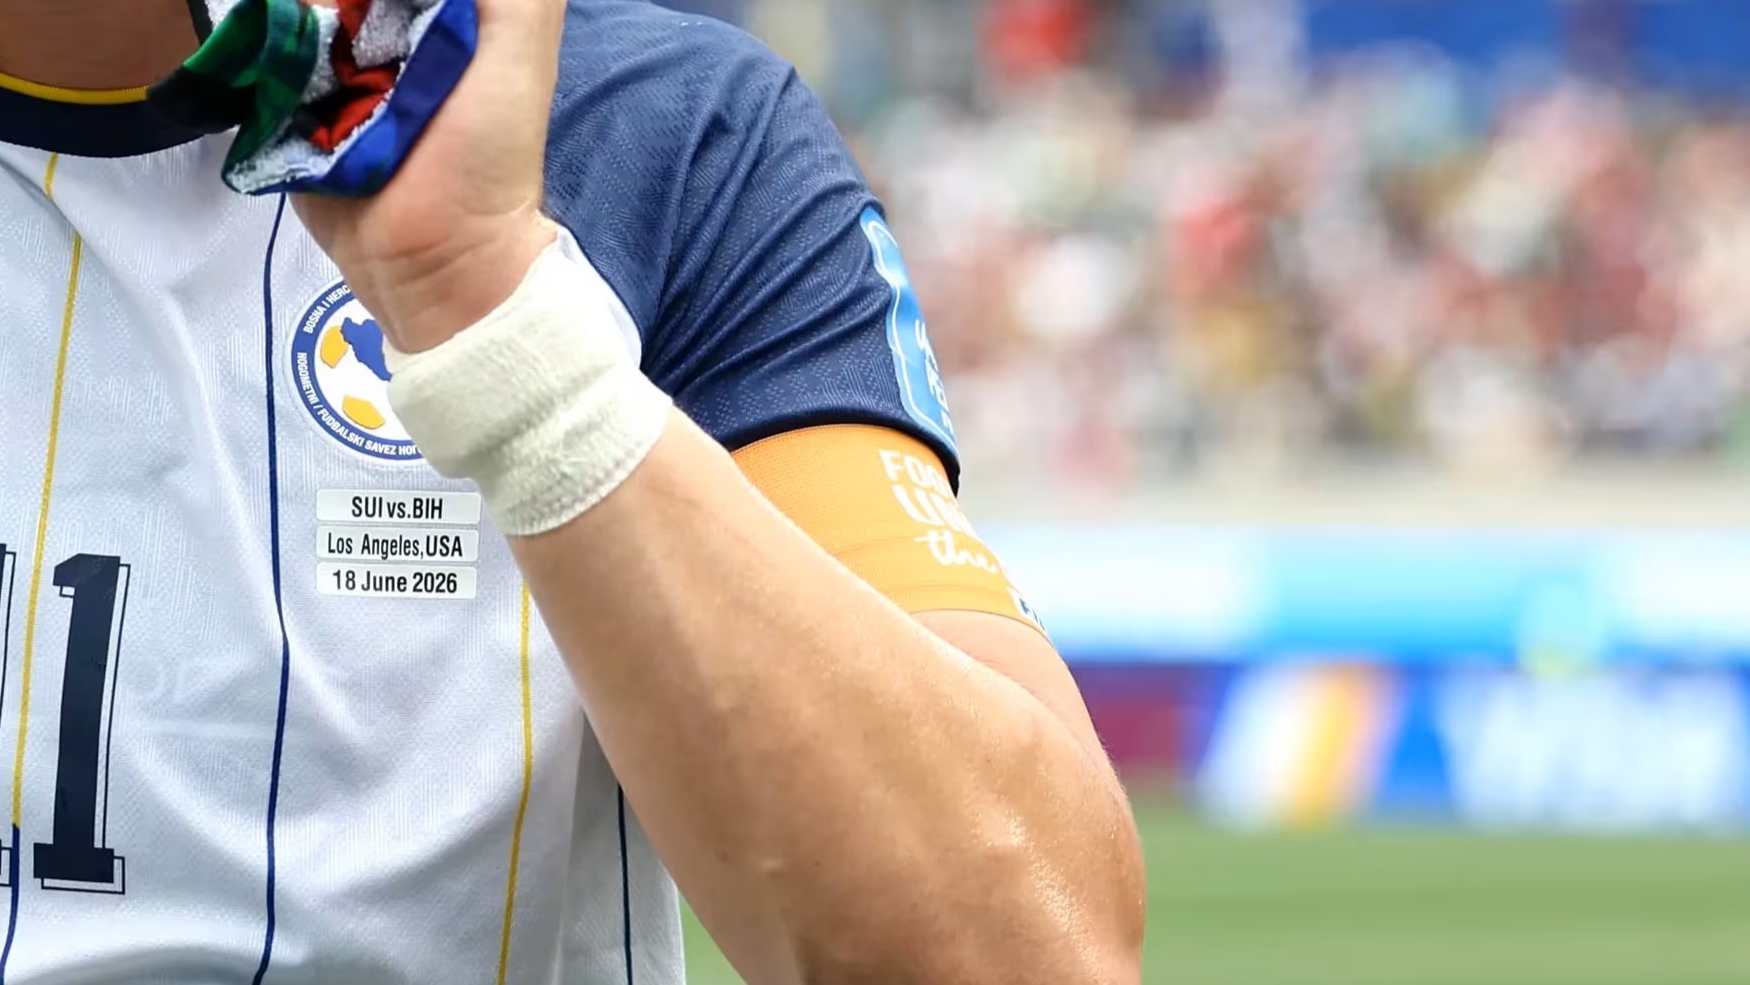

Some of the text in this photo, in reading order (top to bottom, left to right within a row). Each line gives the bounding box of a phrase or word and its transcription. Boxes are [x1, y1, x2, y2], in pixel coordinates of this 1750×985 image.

[303, 305, 326, 334] BOSNA
[328, 284, 351, 306] HERC
[297, 352, 319, 405] NOGOMETNI
[318, 409, 365, 447] FUDBALSKI
[364, 440, 397, 456] SAVEZ
[351, 496, 383, 518] SUI
[328, 532, 353, 554] Los
[333, 569, 458, 594] 18 June 2026
